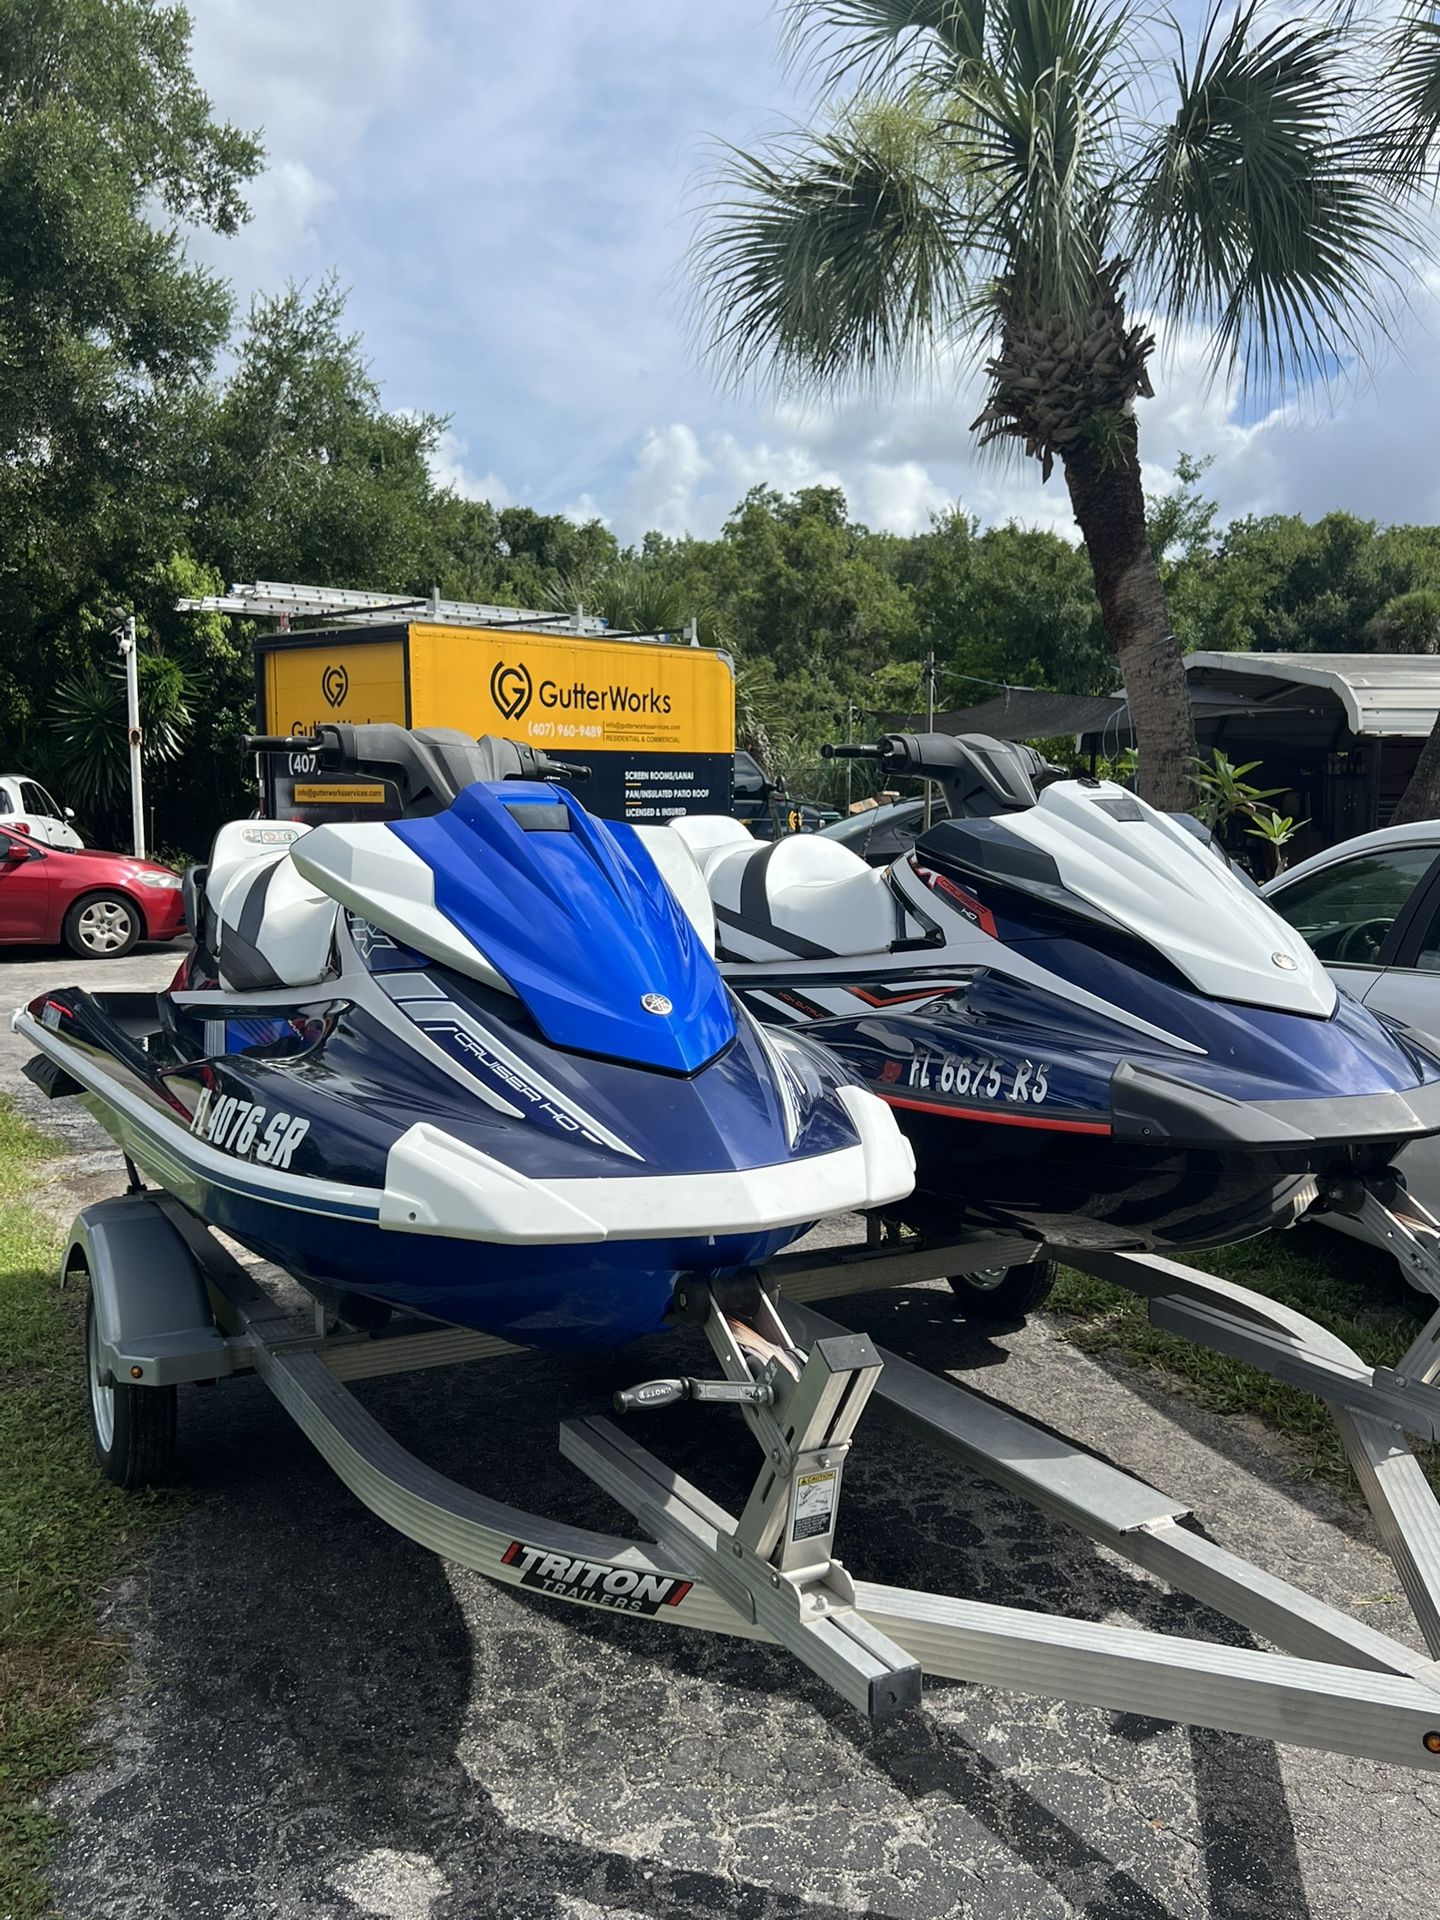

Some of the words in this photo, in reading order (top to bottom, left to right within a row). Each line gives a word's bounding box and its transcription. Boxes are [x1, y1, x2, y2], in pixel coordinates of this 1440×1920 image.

[539, 680, 672, 714] GutterWorks
[528, 721, 555, 737] (407)
[557, 722, 602, 738] 960-9489
[606, 734, 640, 743] RESIDENTIAL
[646, 735, 681, 744] COMMERCIAL
[288, 752, 321, 775] (407
[624, 771, 649, 780] SCREEN
[650, 771, 694, 781] ROOMS/LANAI
[625, 789, 673, 799] PAN/INSULATED
[673, 789, 691, 798] PATIO
[692, 789, 709, 798] ROOF
[625, 808, 655, 817] LICENSED
[661, 807, 687, 816] INSURED
[961, 908, 978, 920] HO
[454, 1031, 542, 1102] CRUISER
[539, 1103, 579, 1131] HO
[909, 1050, 931, 1088] FL
[940, 1053, 1004, 1098] 6675
[190, 1087, 213, 1136] FL
[208, 1094, 267, 1154] 4076
[256, 1112, 310, 1169] SR
[808, 1471, 834, 1484] CAUTION
[519, 1546, 675, 1603] TRITON
[542, 1579, 643, 1612] TRAILERS
